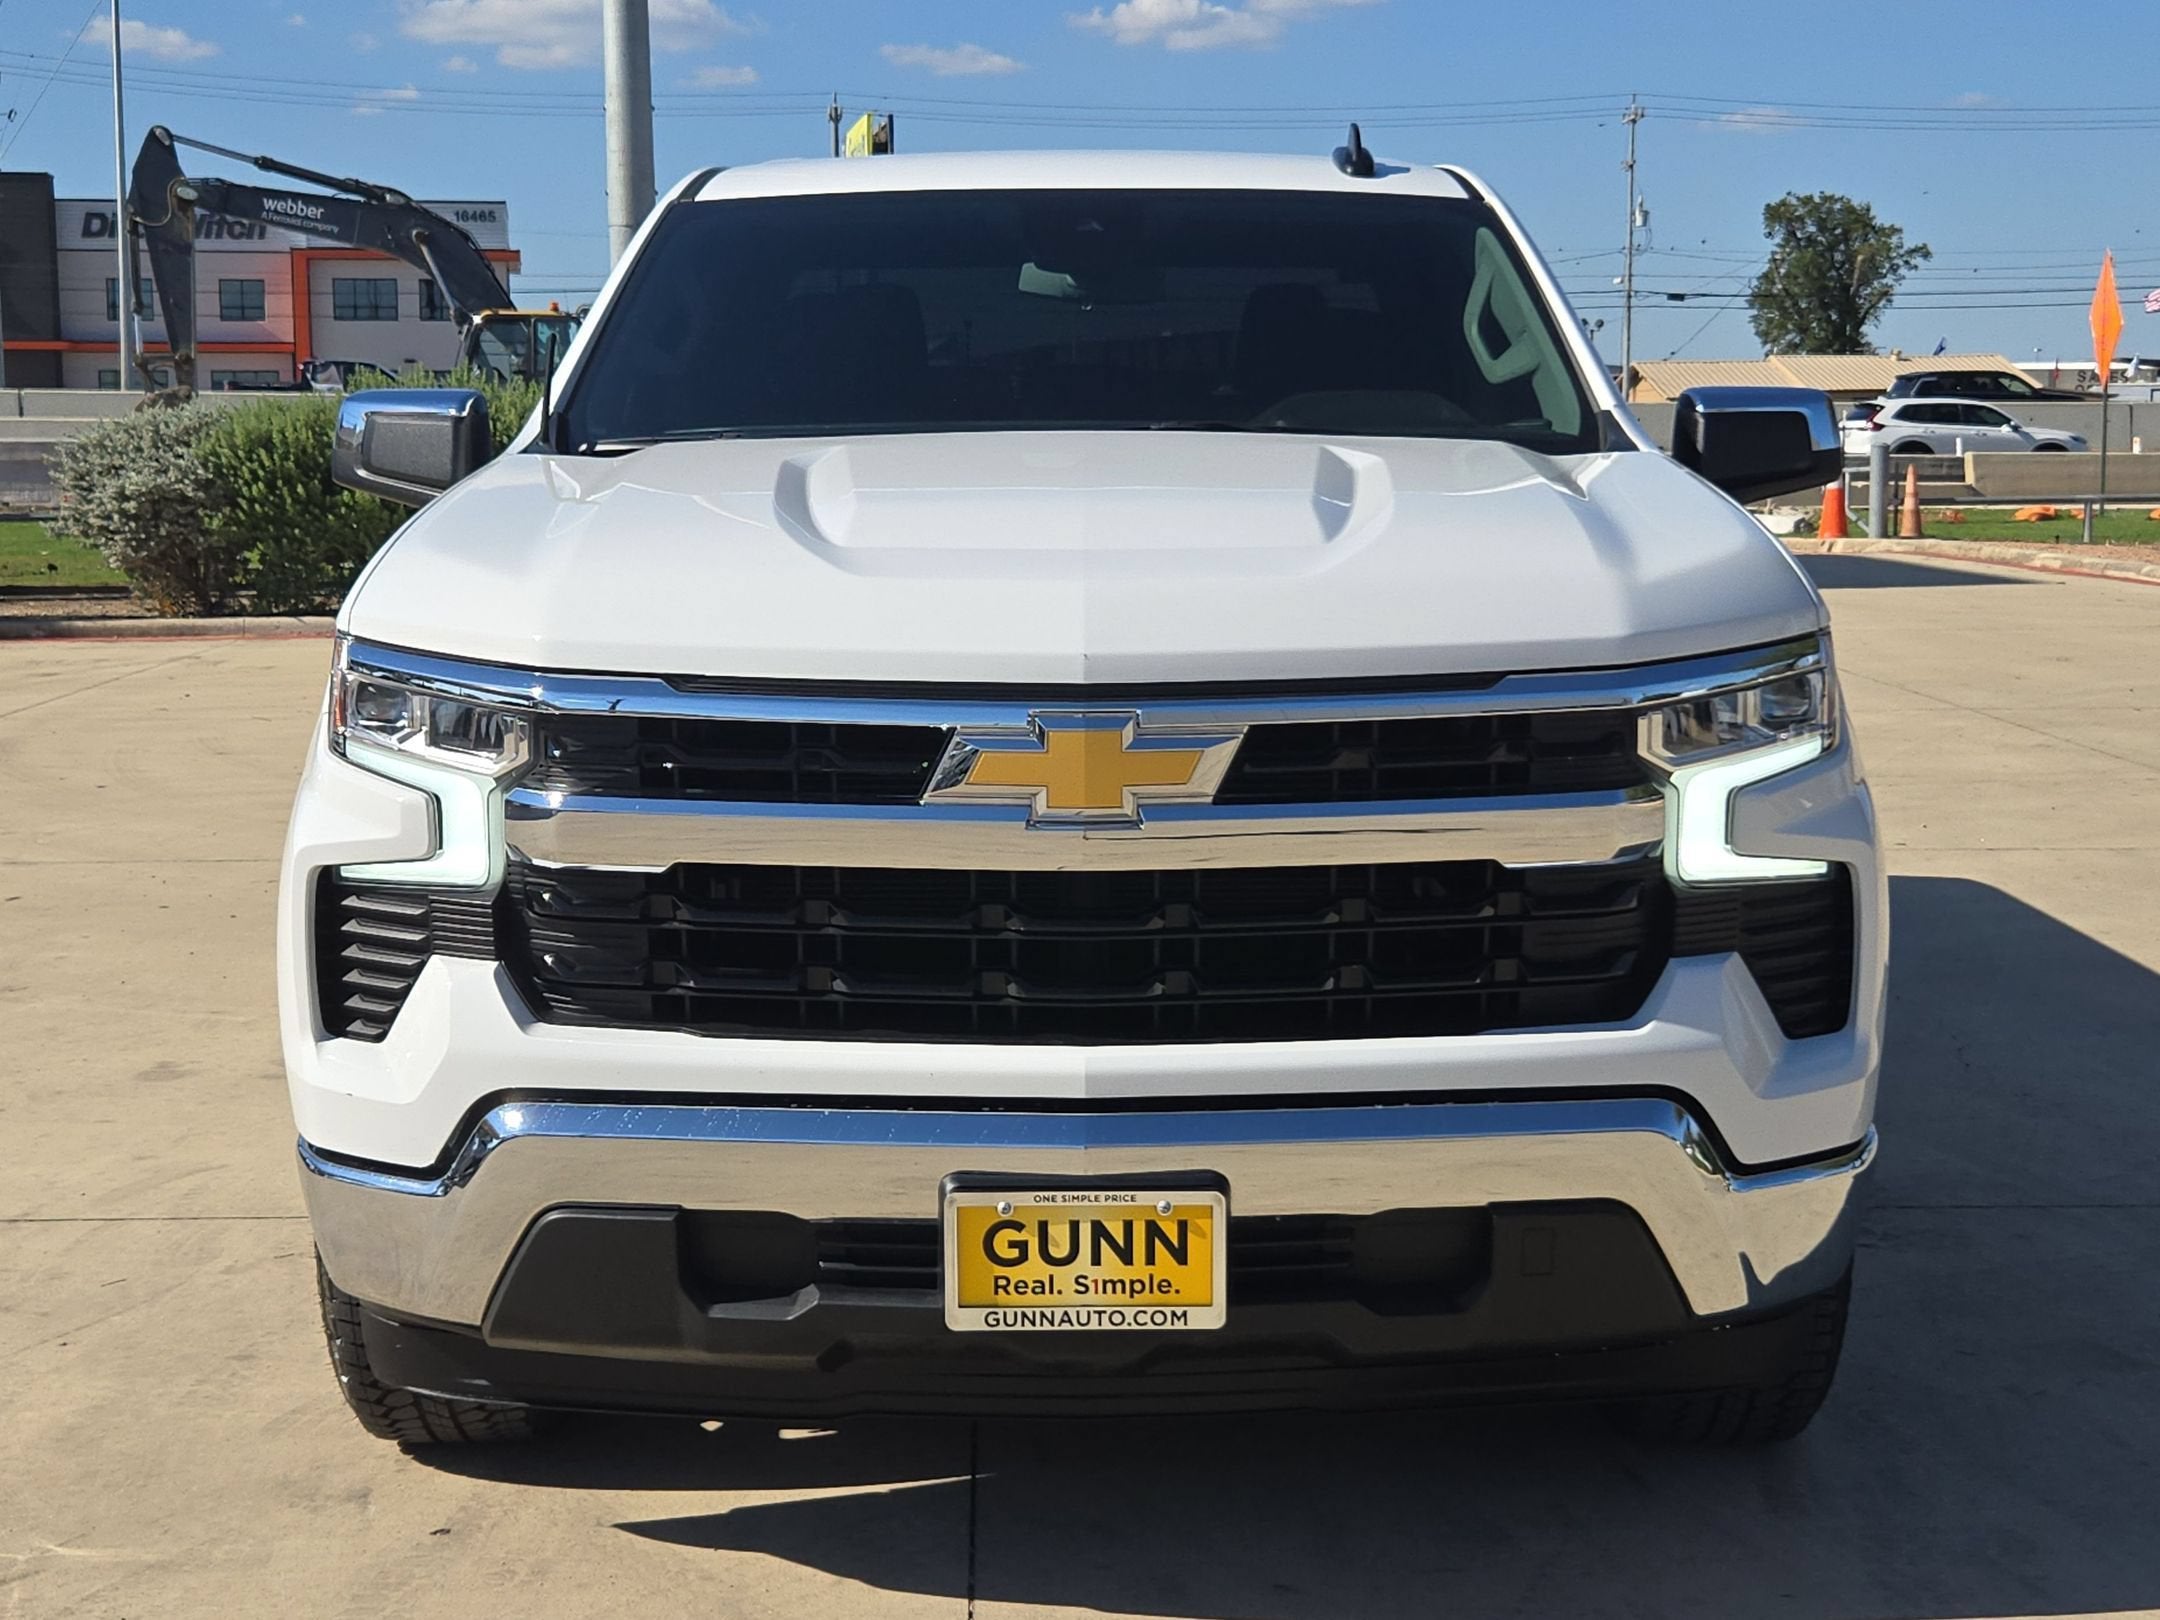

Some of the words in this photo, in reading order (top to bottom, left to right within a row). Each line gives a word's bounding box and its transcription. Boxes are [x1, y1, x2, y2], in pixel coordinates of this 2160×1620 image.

[262, 198, 325, 220] webber
[454, 210, 497, 223] 16465
[195, 211, 267, 240] itch
[2077, 370, 2129, 383] SAES
[1033, 1194, 1059, 1204] ONE
[1061, 1194, 1101, 1203] SIMPLE
[1104, 1194, 1137, 1203] PRICE
[982, 1219, 1189, 1268] GUNN
[993, 1274, 1063, 1296] Real.
[984, 1310, 1188, 1328] GUNNAUTO.COM
